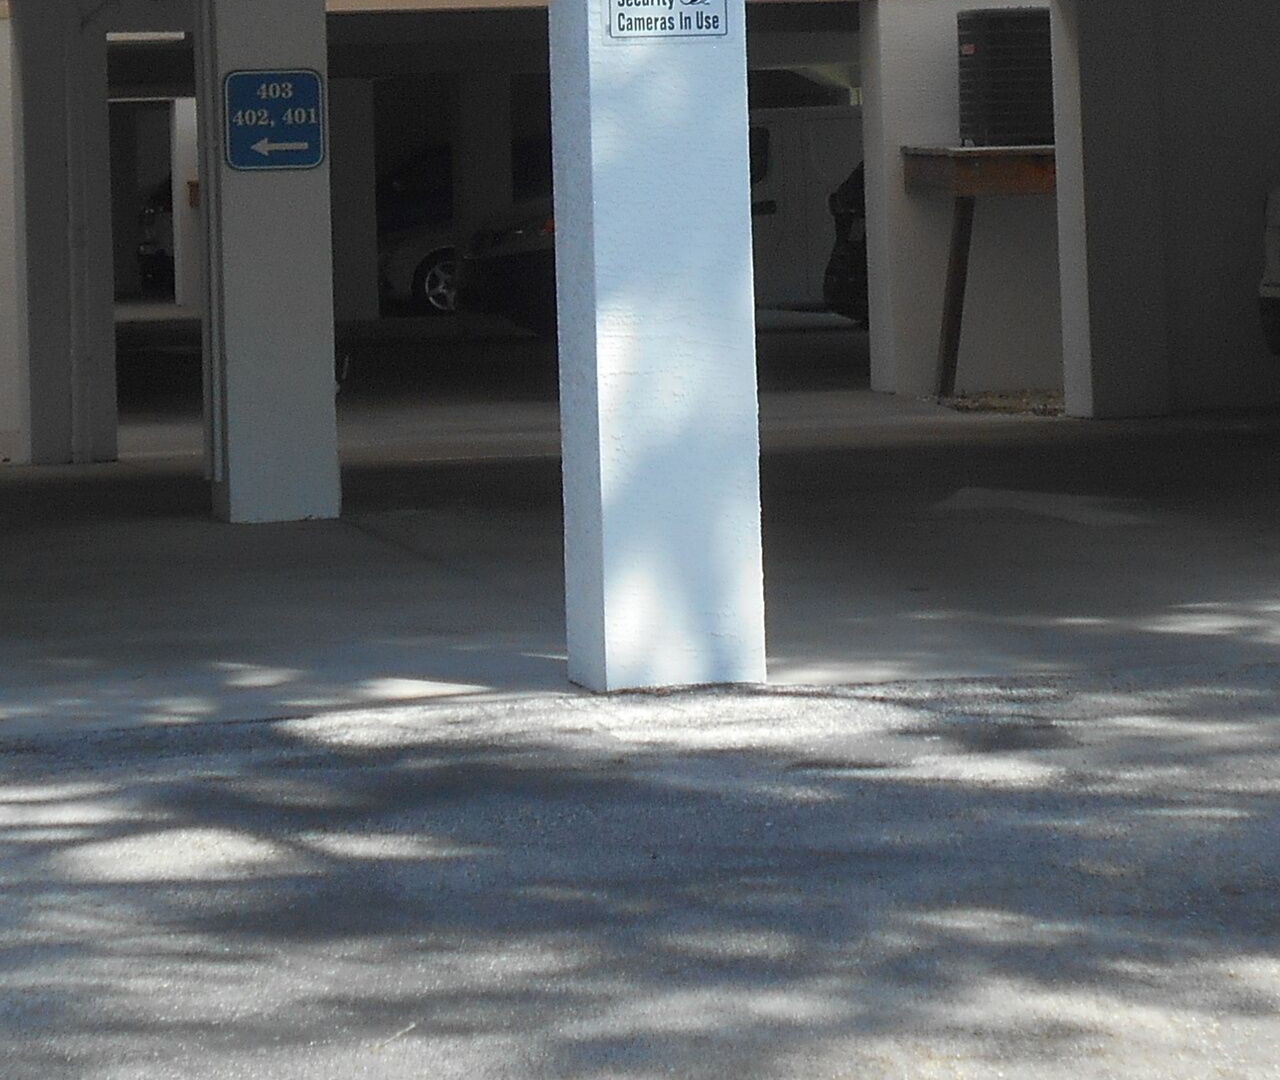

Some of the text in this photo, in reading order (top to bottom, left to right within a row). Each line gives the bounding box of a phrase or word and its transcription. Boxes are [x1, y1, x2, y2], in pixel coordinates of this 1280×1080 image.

[617, 10, 720, 31] Cameras In Use
[256, 82, 294, 99] 403
[232, 107, 318, 128] 402, 401
